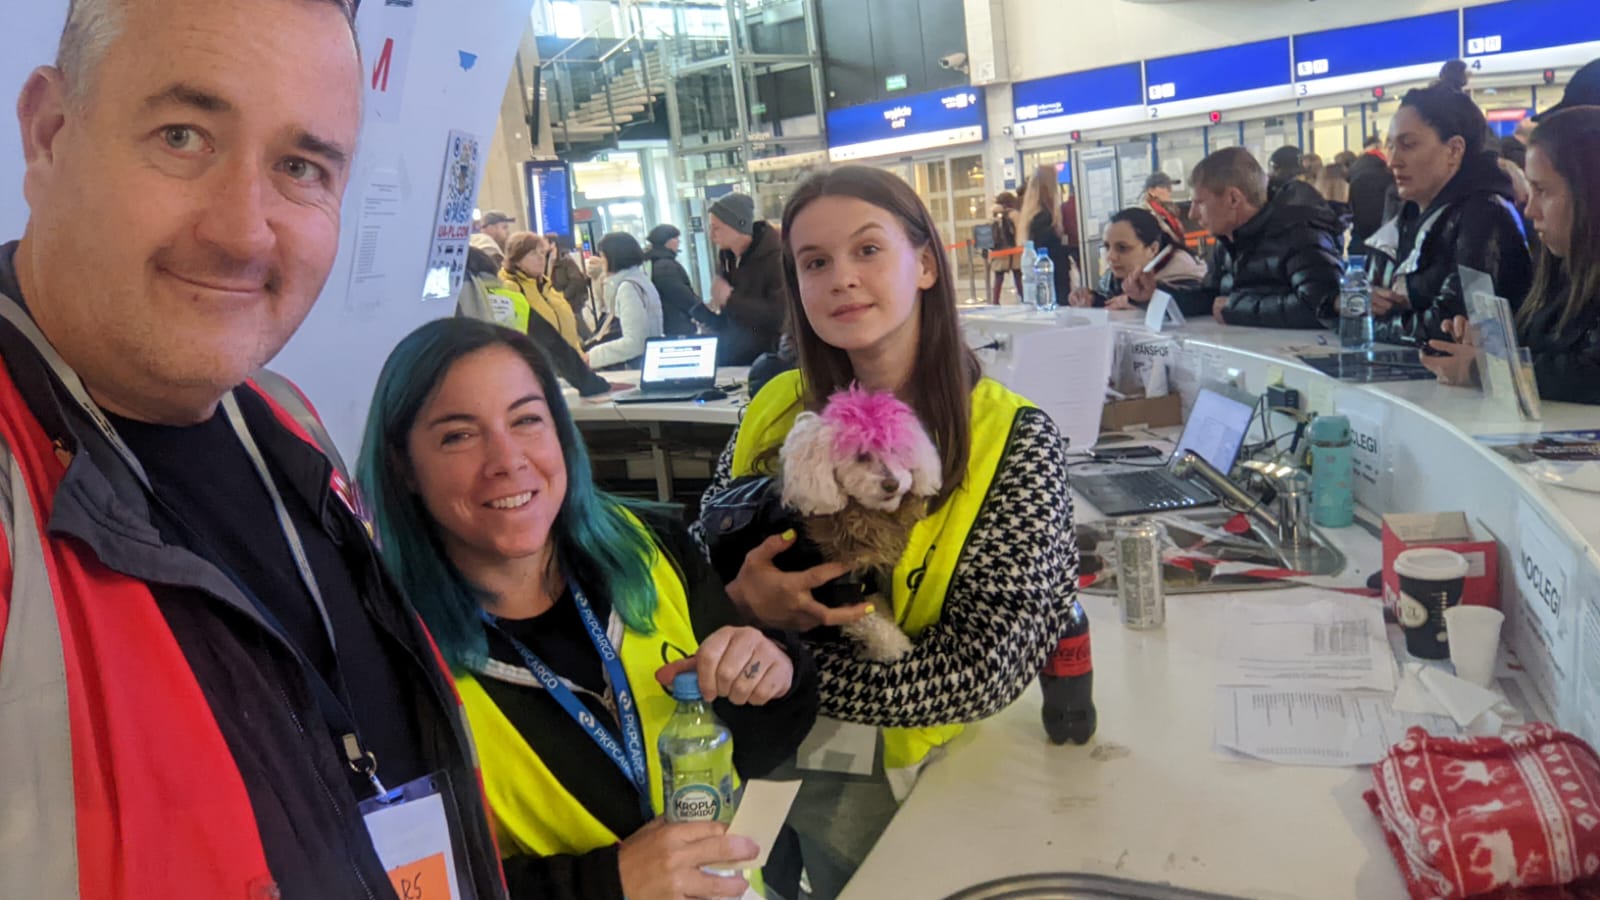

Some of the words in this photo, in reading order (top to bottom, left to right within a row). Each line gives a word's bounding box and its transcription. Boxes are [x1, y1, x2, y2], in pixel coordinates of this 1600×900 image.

[1471, 59, 1482, 70] 4
[1299, 84, 1308, 96] 3
[1151, 108, 1159, 118] 2
[1020, 125, 1026, 135] 1
[583, 608, 616, 661] PKPCARGO
[513, 640, 558, 690] PCARGO
[674, 799, 718, 811] KROPLA
